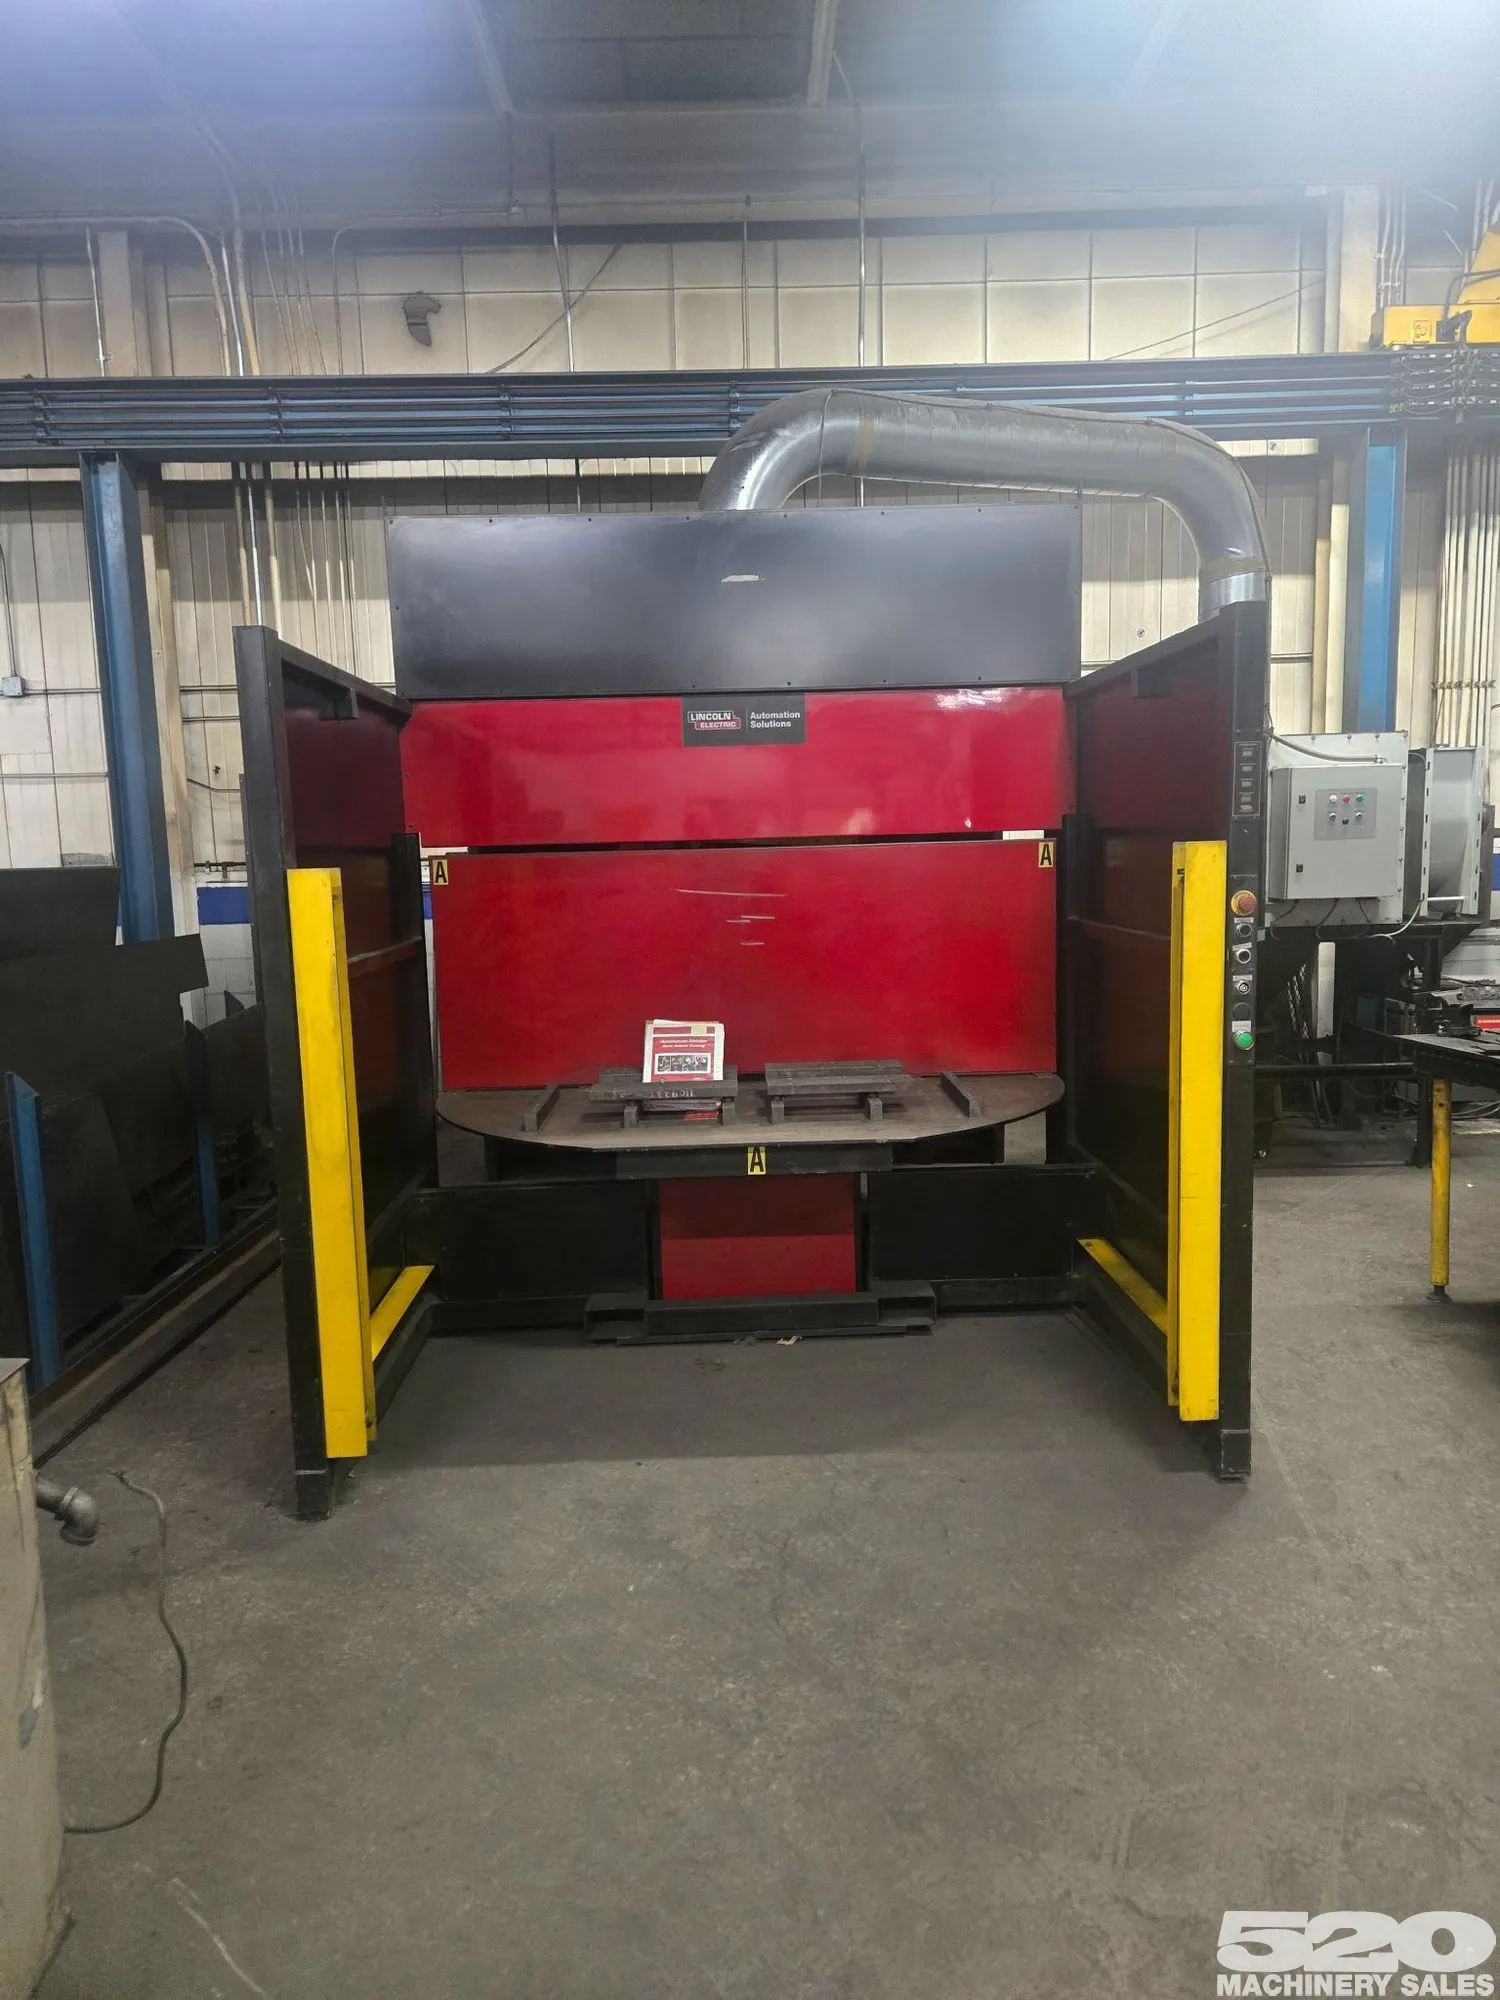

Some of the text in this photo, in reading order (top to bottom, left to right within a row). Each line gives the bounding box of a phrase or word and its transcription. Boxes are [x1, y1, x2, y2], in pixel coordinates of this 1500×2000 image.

[690, 712, 731, 721] LINCOLN
[750, 711, 801, 720] Automation
[700, 721, 736, 729] ELECTRIC
[750, 720, 792, 729] Solutions
[1040, 843, 1052, 866] A
[434, 861, 448, 884] A
[749, 1145, 765, 1173] A
